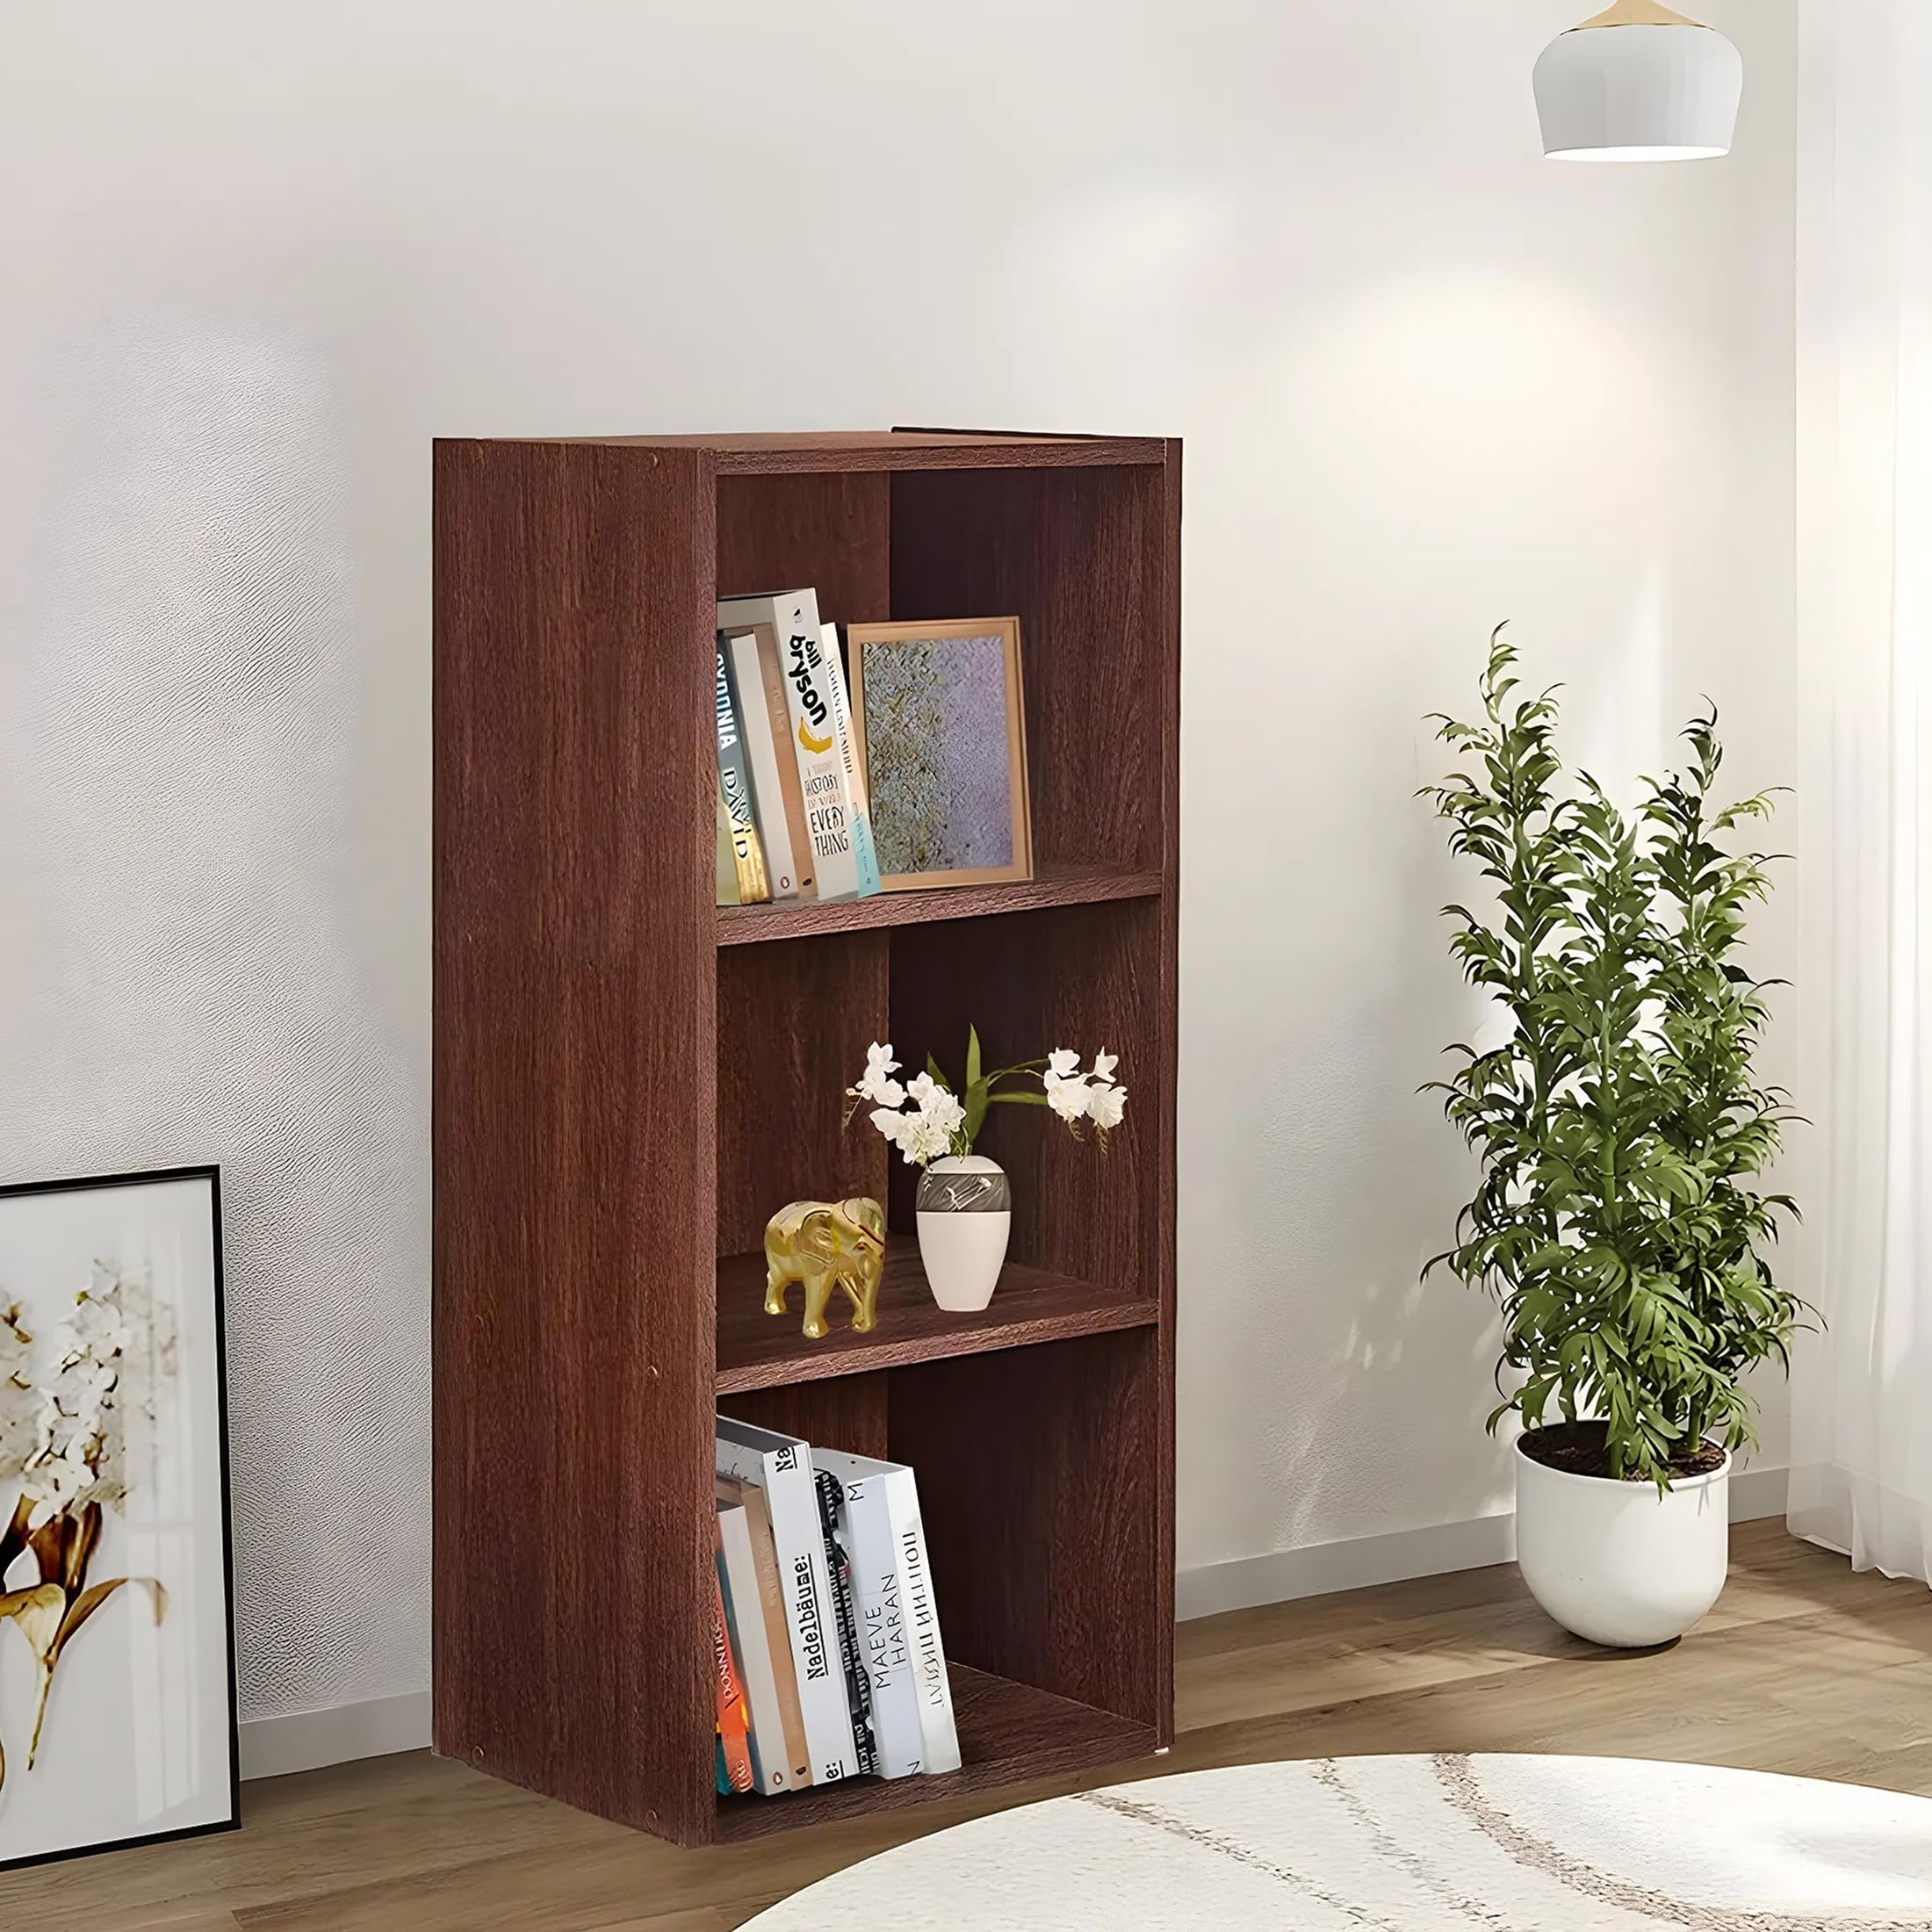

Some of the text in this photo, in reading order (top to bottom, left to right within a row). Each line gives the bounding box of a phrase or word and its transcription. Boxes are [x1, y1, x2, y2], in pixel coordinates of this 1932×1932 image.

[788, 634, 828, 725] bryson
[805, 638, 823, 669] bill
[810, 805, 844, 833] EVERY
[814, 832, 849, 858] THING
[794, 1555, 828, 1679] Nadelbäume:
[866, 1606, 891, 1690] MAEVE
[882, 1574, 908, 1666] HARAN
